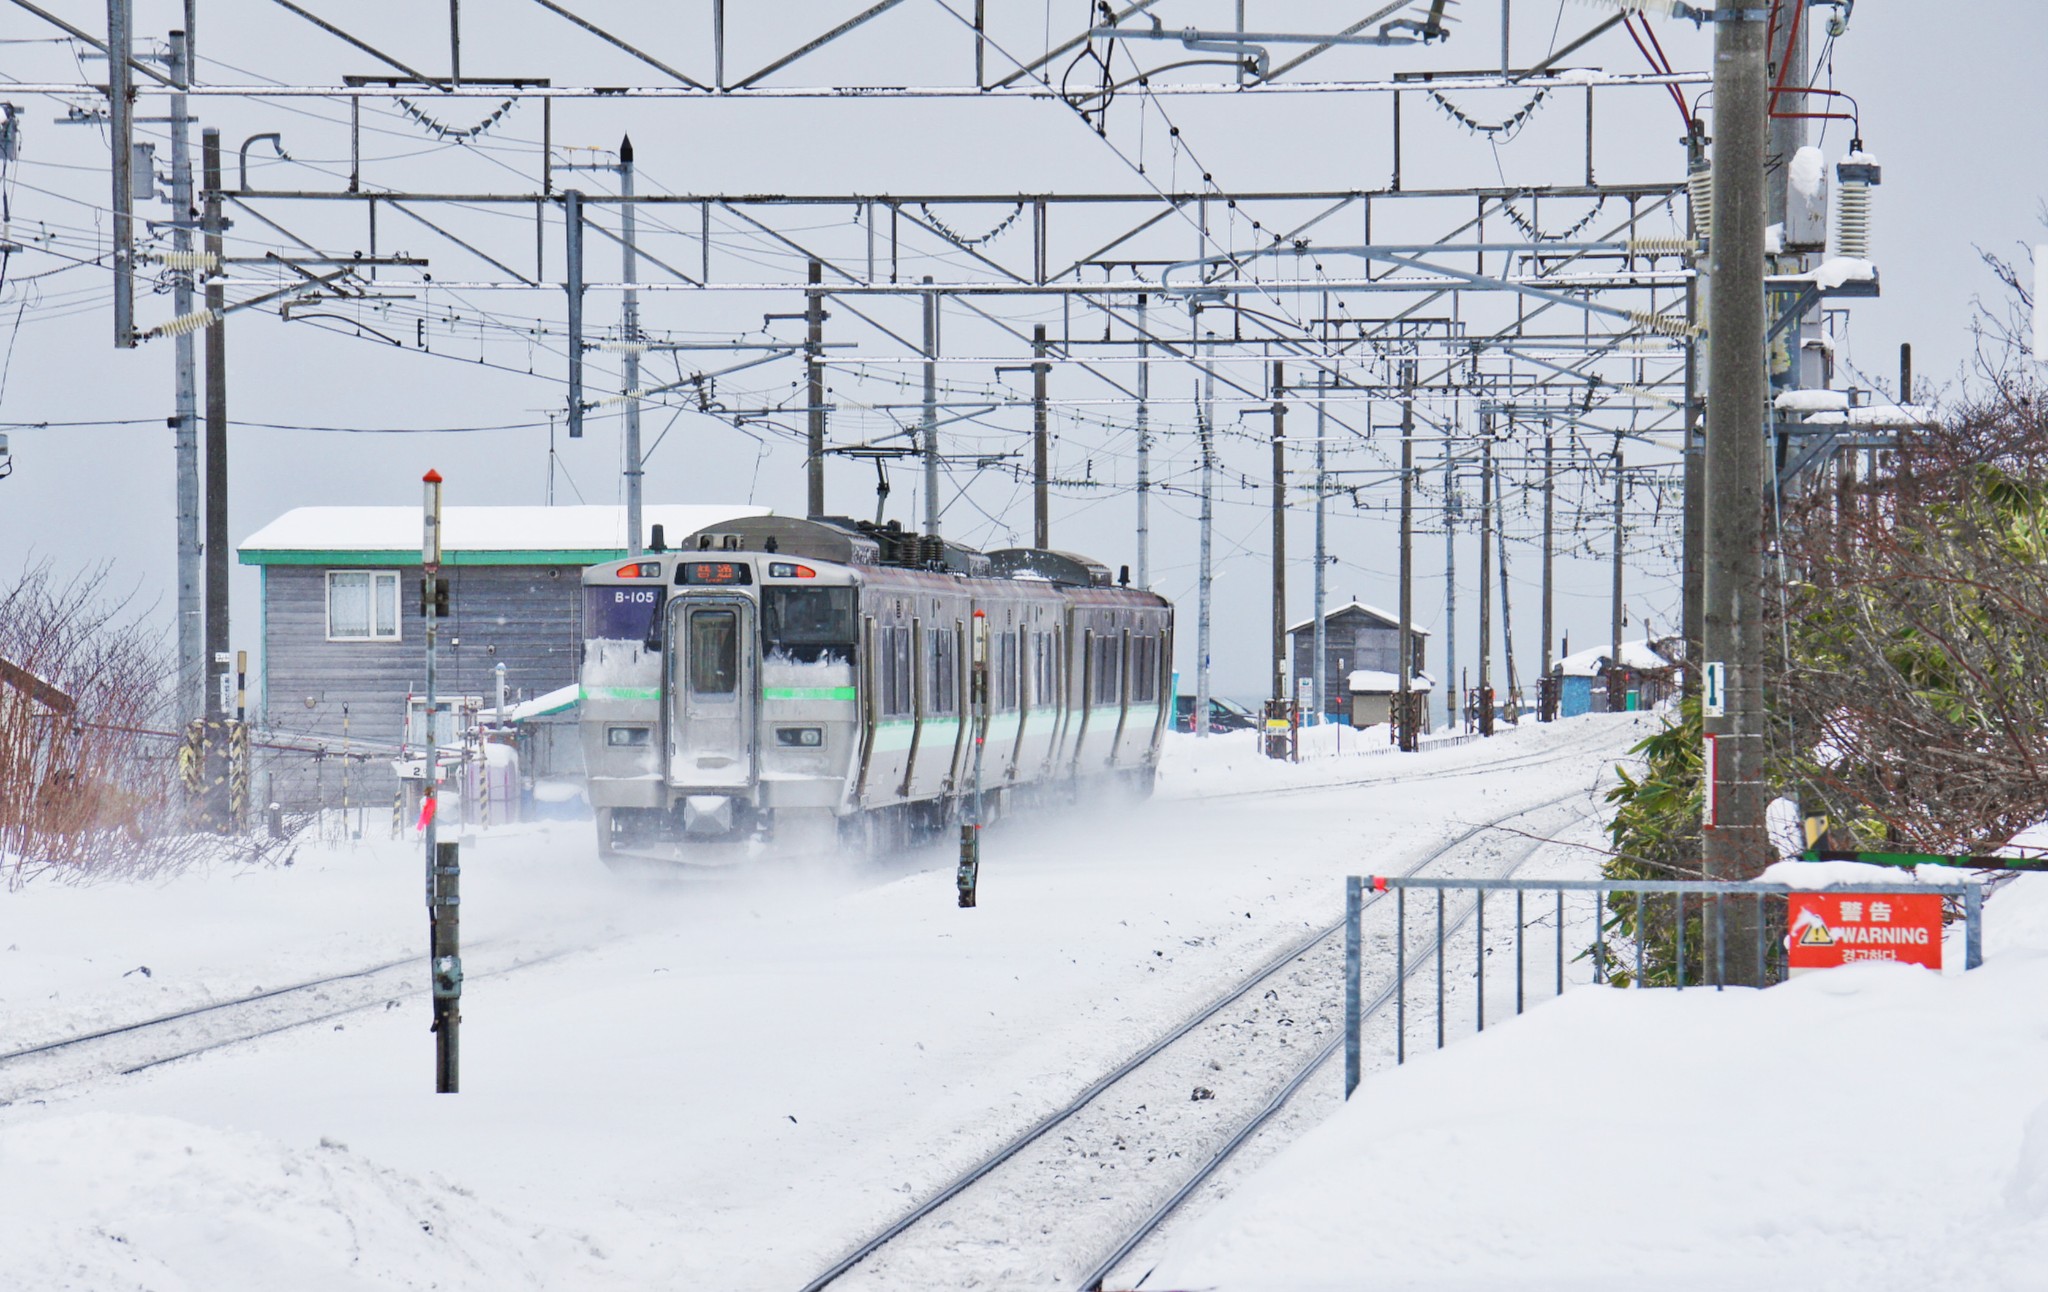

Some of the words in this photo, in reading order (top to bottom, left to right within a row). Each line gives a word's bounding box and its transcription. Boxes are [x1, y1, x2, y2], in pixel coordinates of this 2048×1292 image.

[615, 591, 654, 603] B-105
[1839, 902, 1892, 922] 警告
[1842, 927, 1928, 944] WARNING
